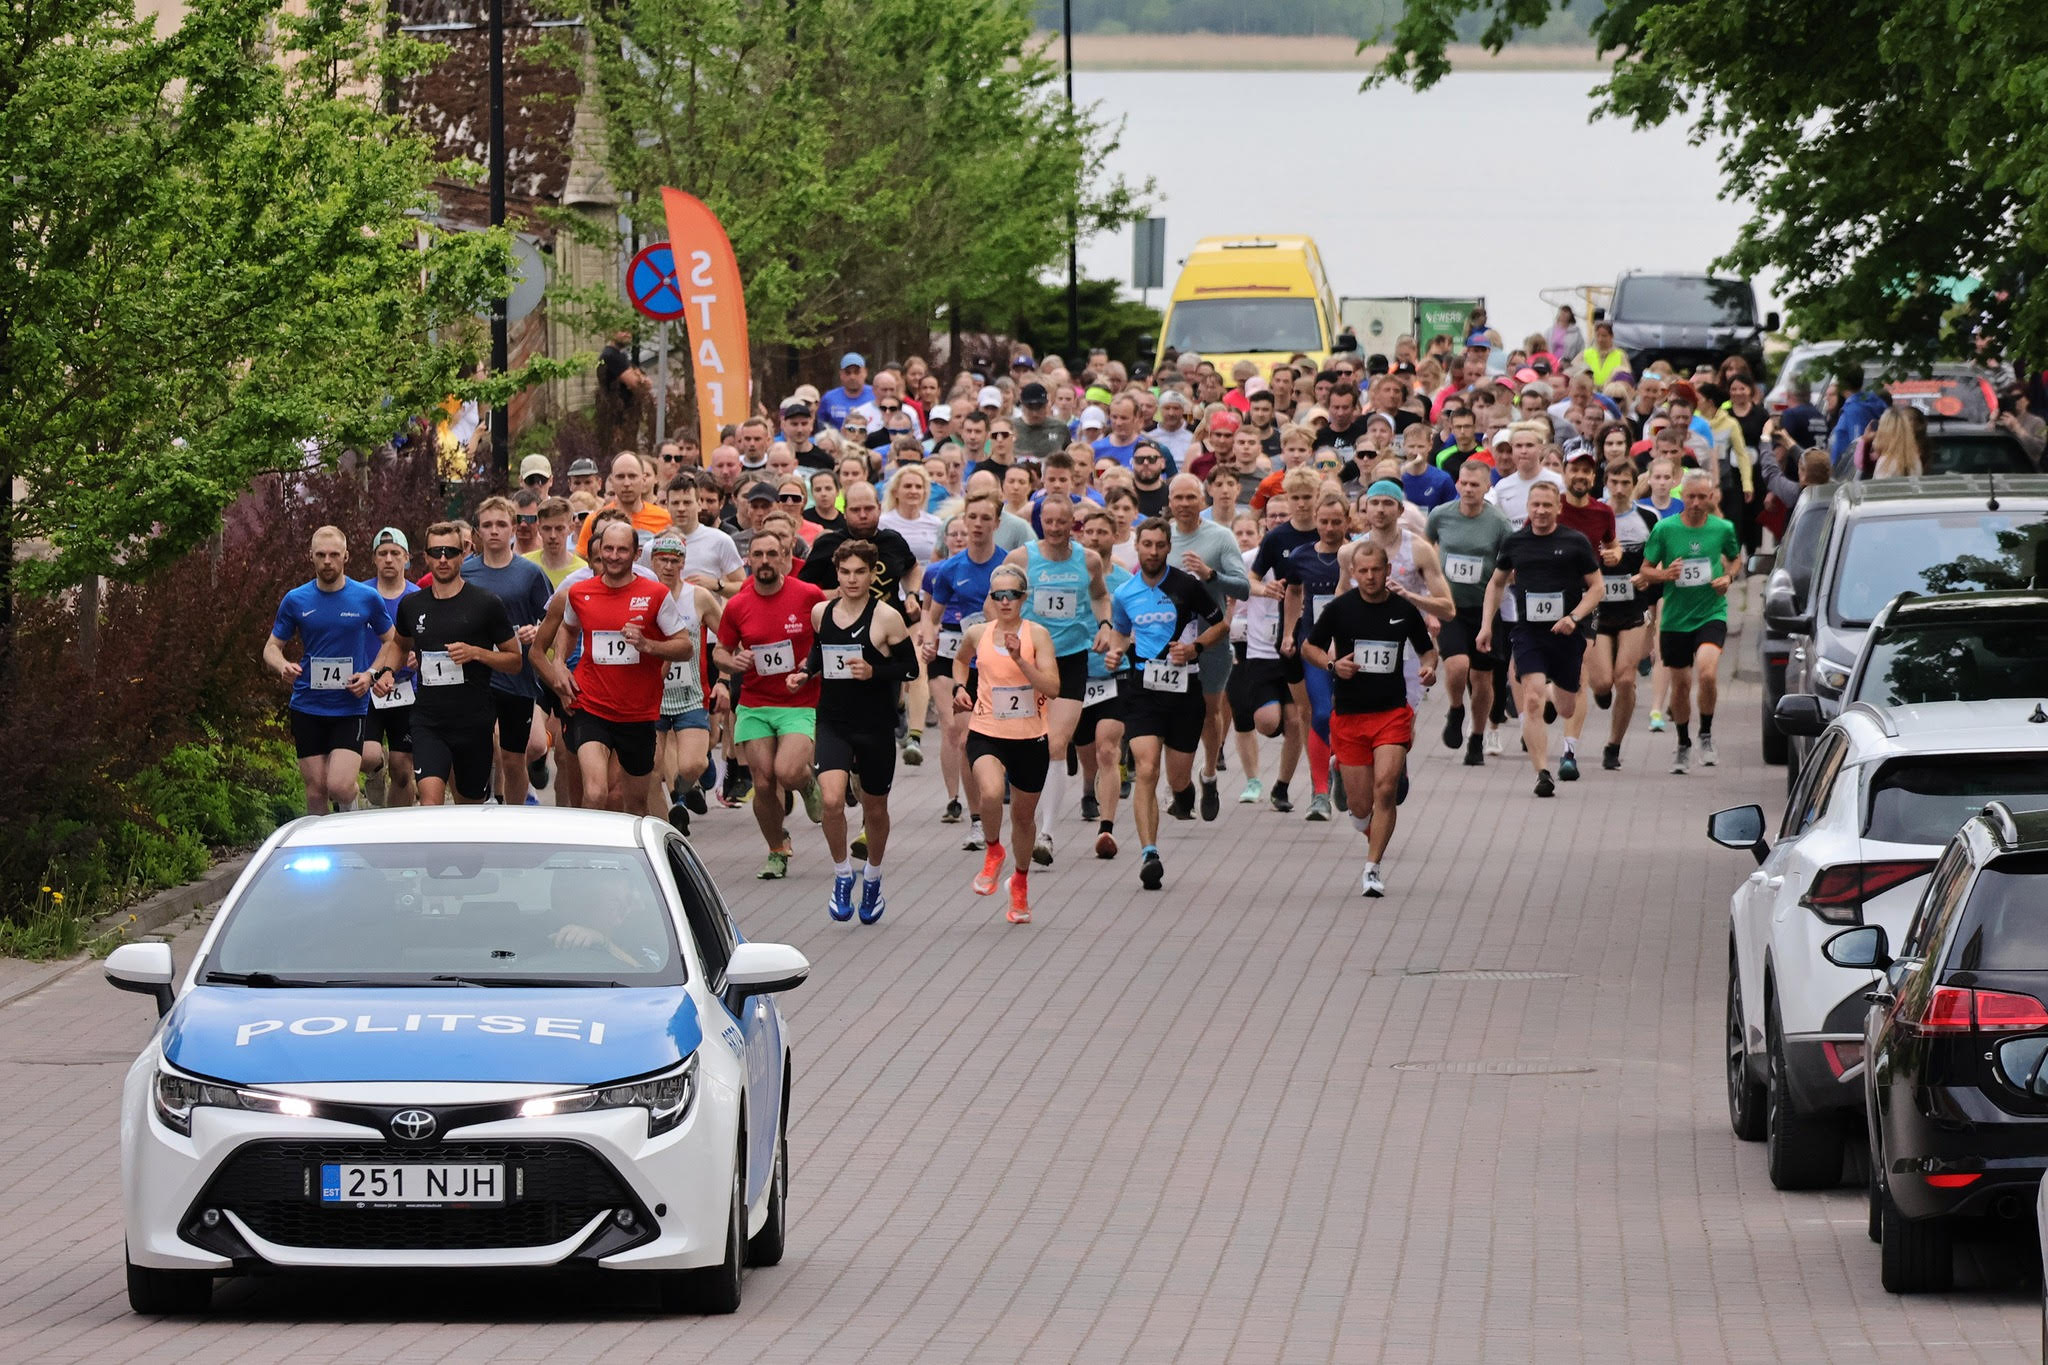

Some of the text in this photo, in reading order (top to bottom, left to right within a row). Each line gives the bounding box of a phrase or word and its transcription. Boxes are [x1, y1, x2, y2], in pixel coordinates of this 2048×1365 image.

[1453, 562, 1474, 577] 151
[1683, 566, 1701, 580] 55
[1605, 583, 1627, 595] 198
[1048, 596, 1065, 611] 13
[1535, 602, 1553, 615] 49
[1135, 612, 1176, 625] coop
[607, 640, 627, 656] 19
[763, 651, 783, 668] 96
[836, 655, 845, 671] 3
[1363, 650, 1391, 666] 113
[322, 667, 341, 682] 74
[435, 661, 443, 677] 1
[1152, 670, 1180, 685] 142
[1087, 685, 1105, 699] 95
[1010, 695, 1019, 711] 2
[235, 1013, 606, 1047] POLITSEI
[348, 1168, 495, 1197] 251 NJH
[323, 1188, 340, 1197] EST
